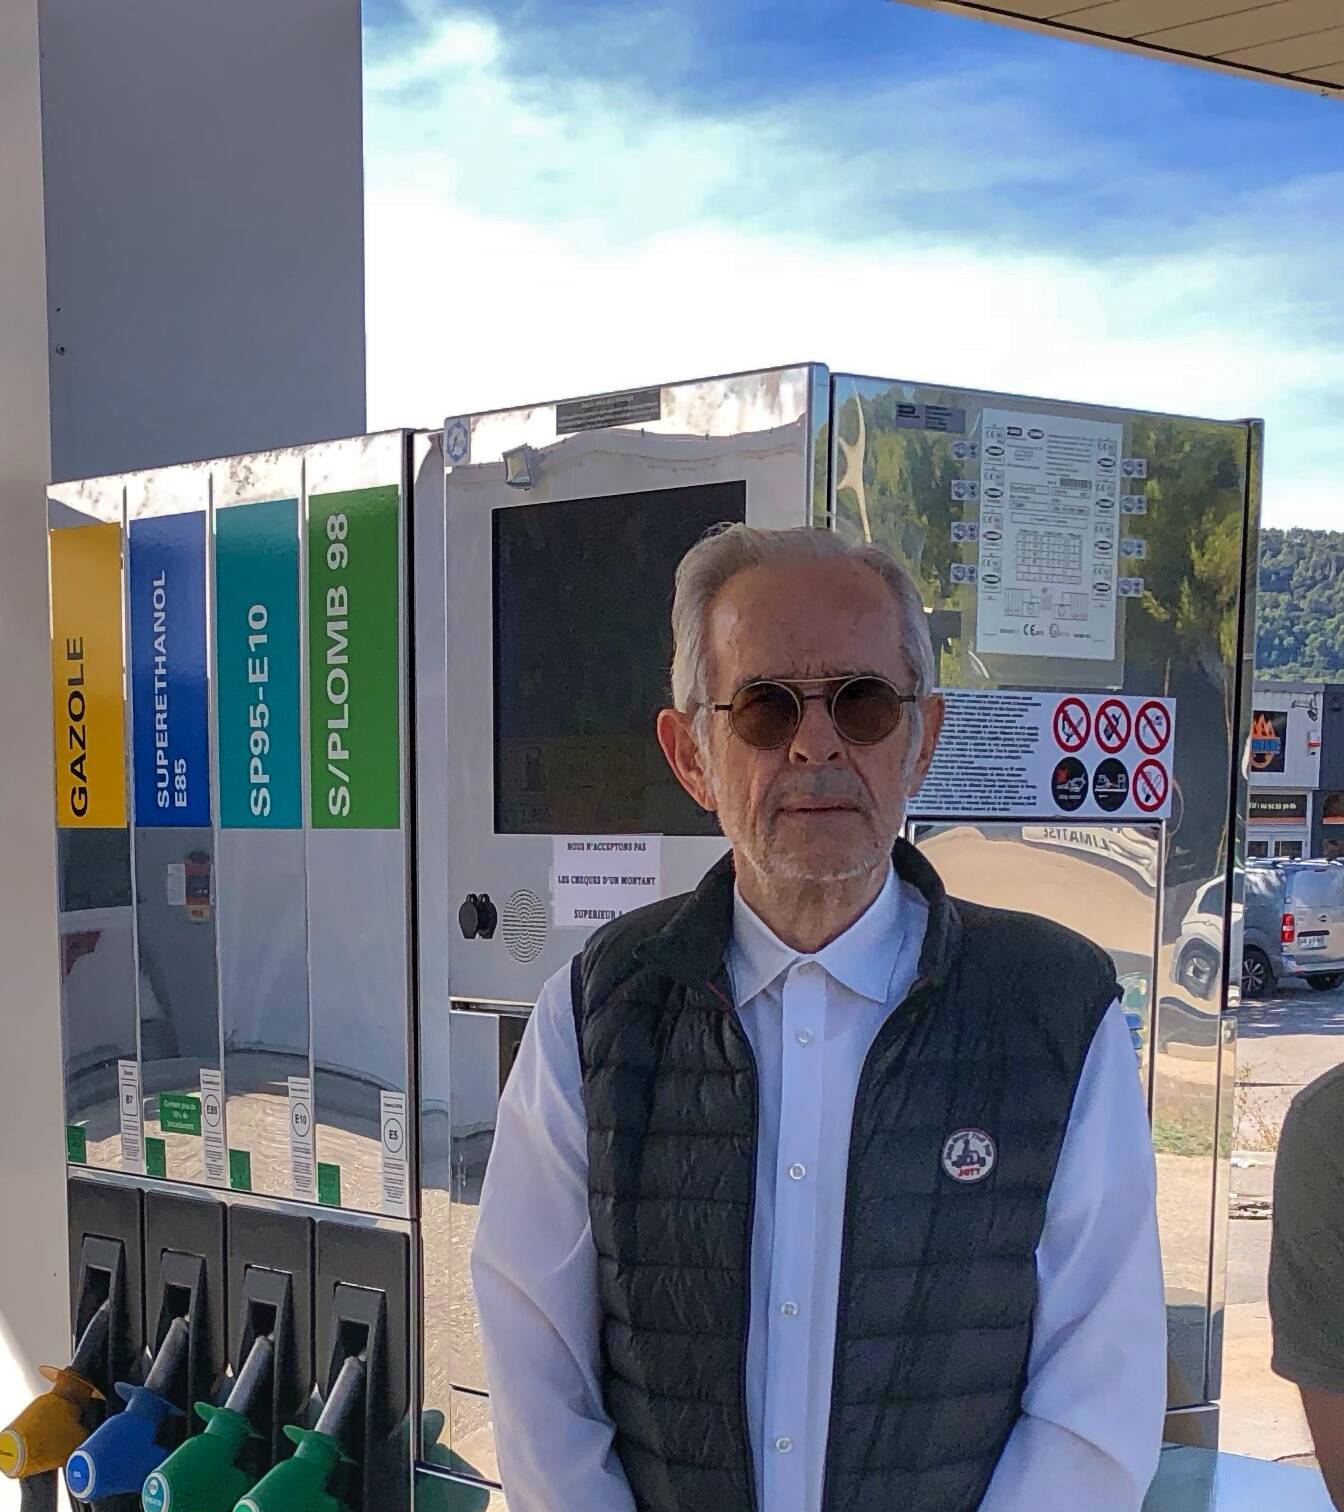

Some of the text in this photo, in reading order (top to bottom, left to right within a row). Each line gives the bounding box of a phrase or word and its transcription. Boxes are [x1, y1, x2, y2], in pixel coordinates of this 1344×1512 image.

[152, 570, 170, 808] SUPERETHANOL
[325, 512, 351, 817] S/PLOMB 98
[66, 636, 88, 817] GAZOLE
[246, 603, 271, 817] SP95-E10
[174, 758, 188, 808] E85
[633, 842, 646, 851] PAS
[557, 875, 570, 884] LES
[620, 876, 656, 886] MONTANT
[294, 1114, 307, 1125] E10
[388, 1129, 399, 1140] E5
